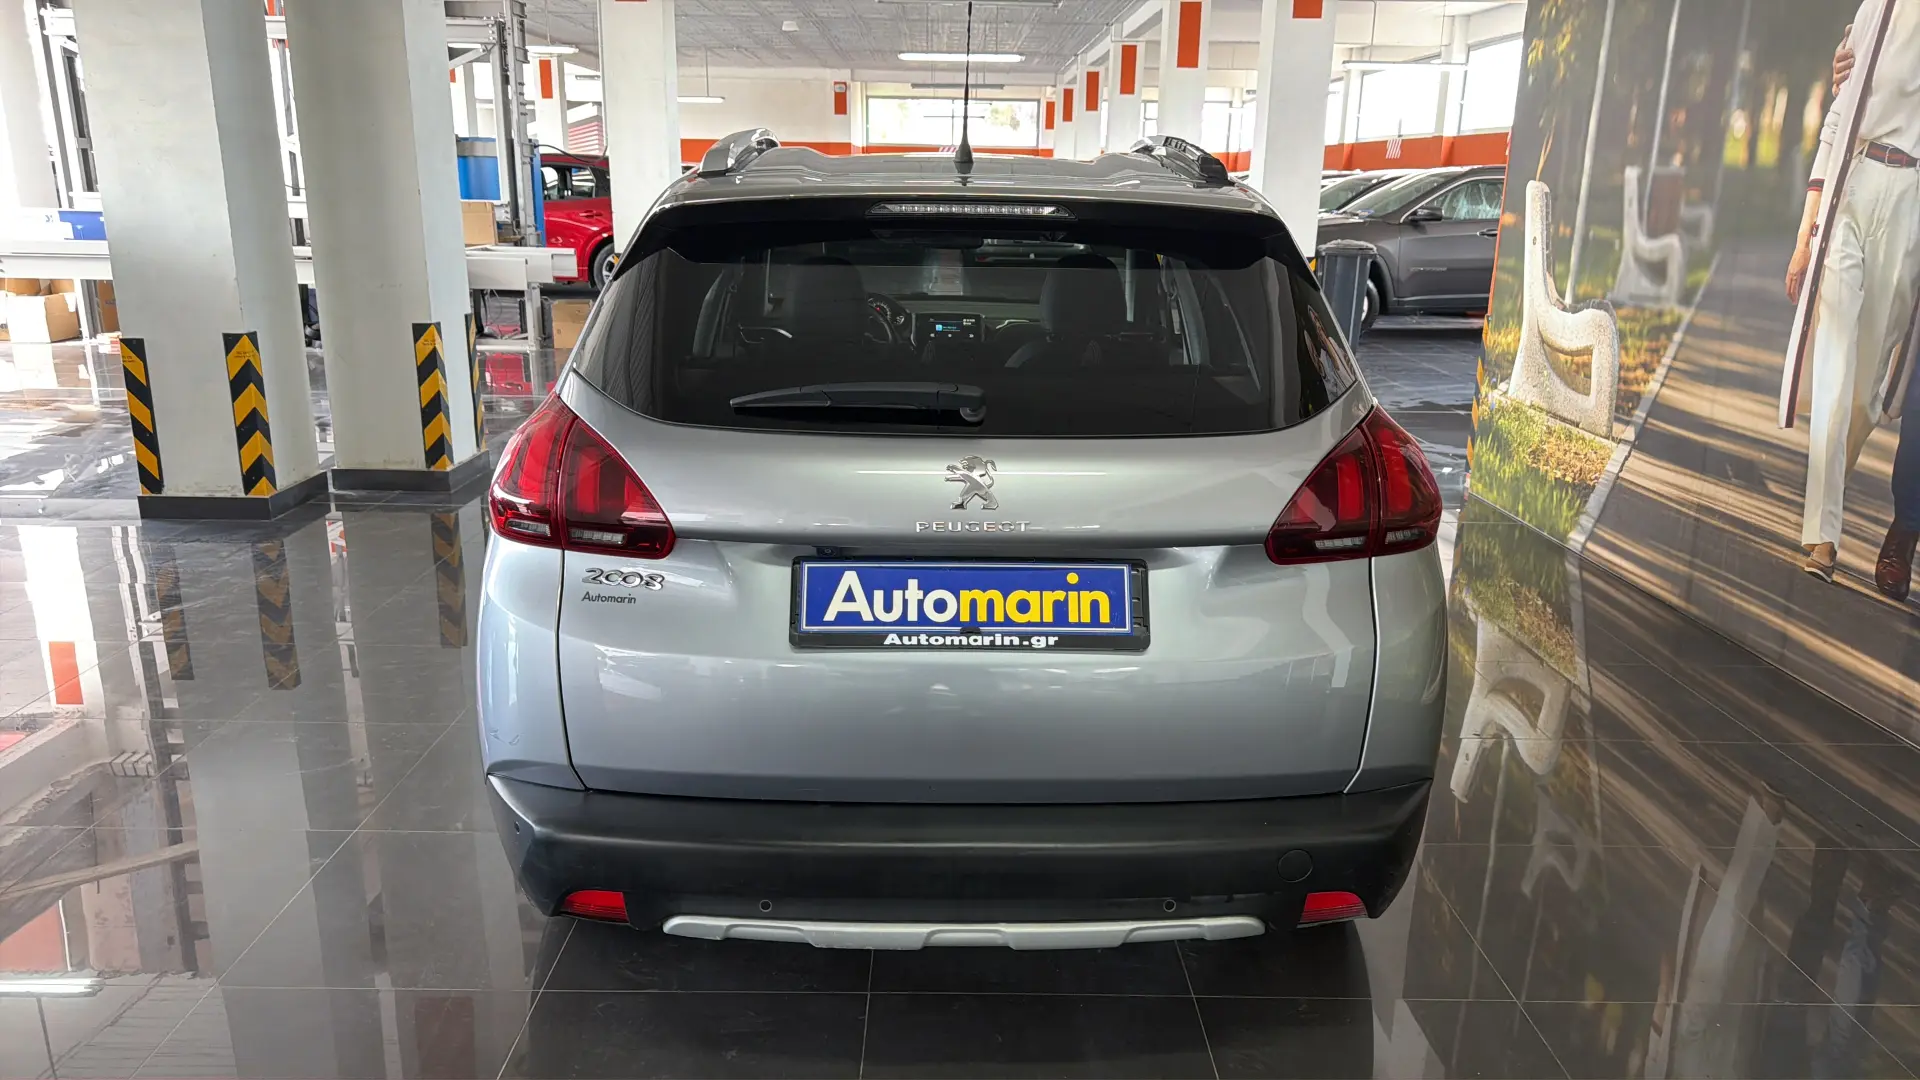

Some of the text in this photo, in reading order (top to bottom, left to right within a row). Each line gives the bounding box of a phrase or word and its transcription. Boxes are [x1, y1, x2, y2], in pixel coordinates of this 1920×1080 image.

[915, 521, 1031, 533] PEUGEOT
[581, 567, 665, 591] 2008
[581, 591, 637, 605] Automarin
[822, 570, 1111, 623] Automarin
[883, 633, 1060, 648] Automarin.gr
